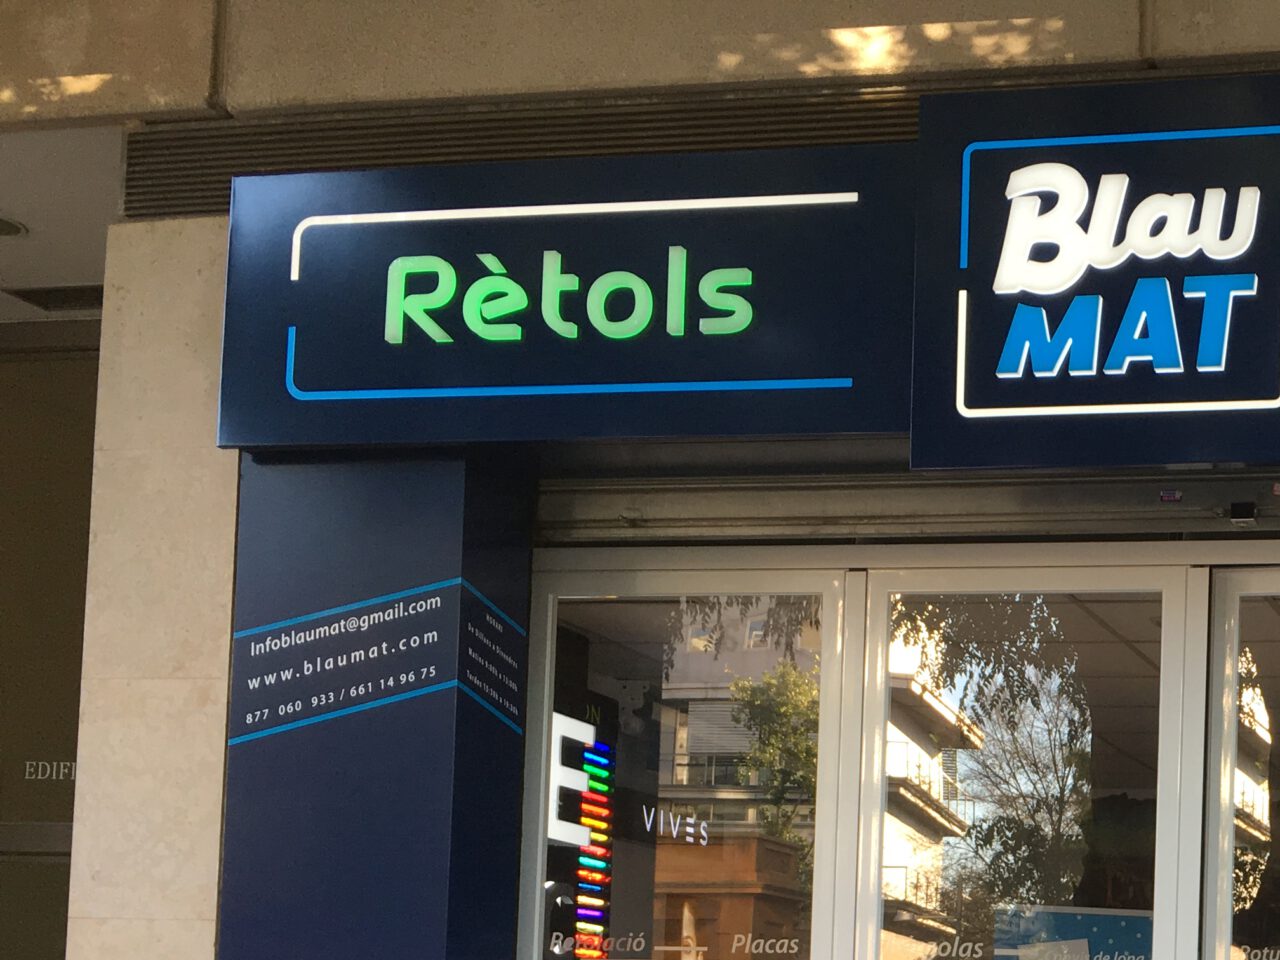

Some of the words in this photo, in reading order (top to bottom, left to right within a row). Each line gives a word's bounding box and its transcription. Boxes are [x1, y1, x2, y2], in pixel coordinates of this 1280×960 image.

[992, 162, 1260, 295] Blau
[384, 246, 753, 344] Rètols
[996, 273, 1258, 378] MAT
[250, 596, 441, 657] Infoblaumat@gmail.com
[248, 630, 438, 690] www.blaumat.com
[246, 709, 269, 724] 877
[278, 700, 302, 716] 060
[311, 692, 334, 707] 933
[340, 689, 345, 701] /
[350, 684, 373, 697] 661
[380, 676, 394, 690] 14
[400, 671, 415, 685] 96
[421, 666, 436, 680] 75
[732, 934, 799, 954] Placas
